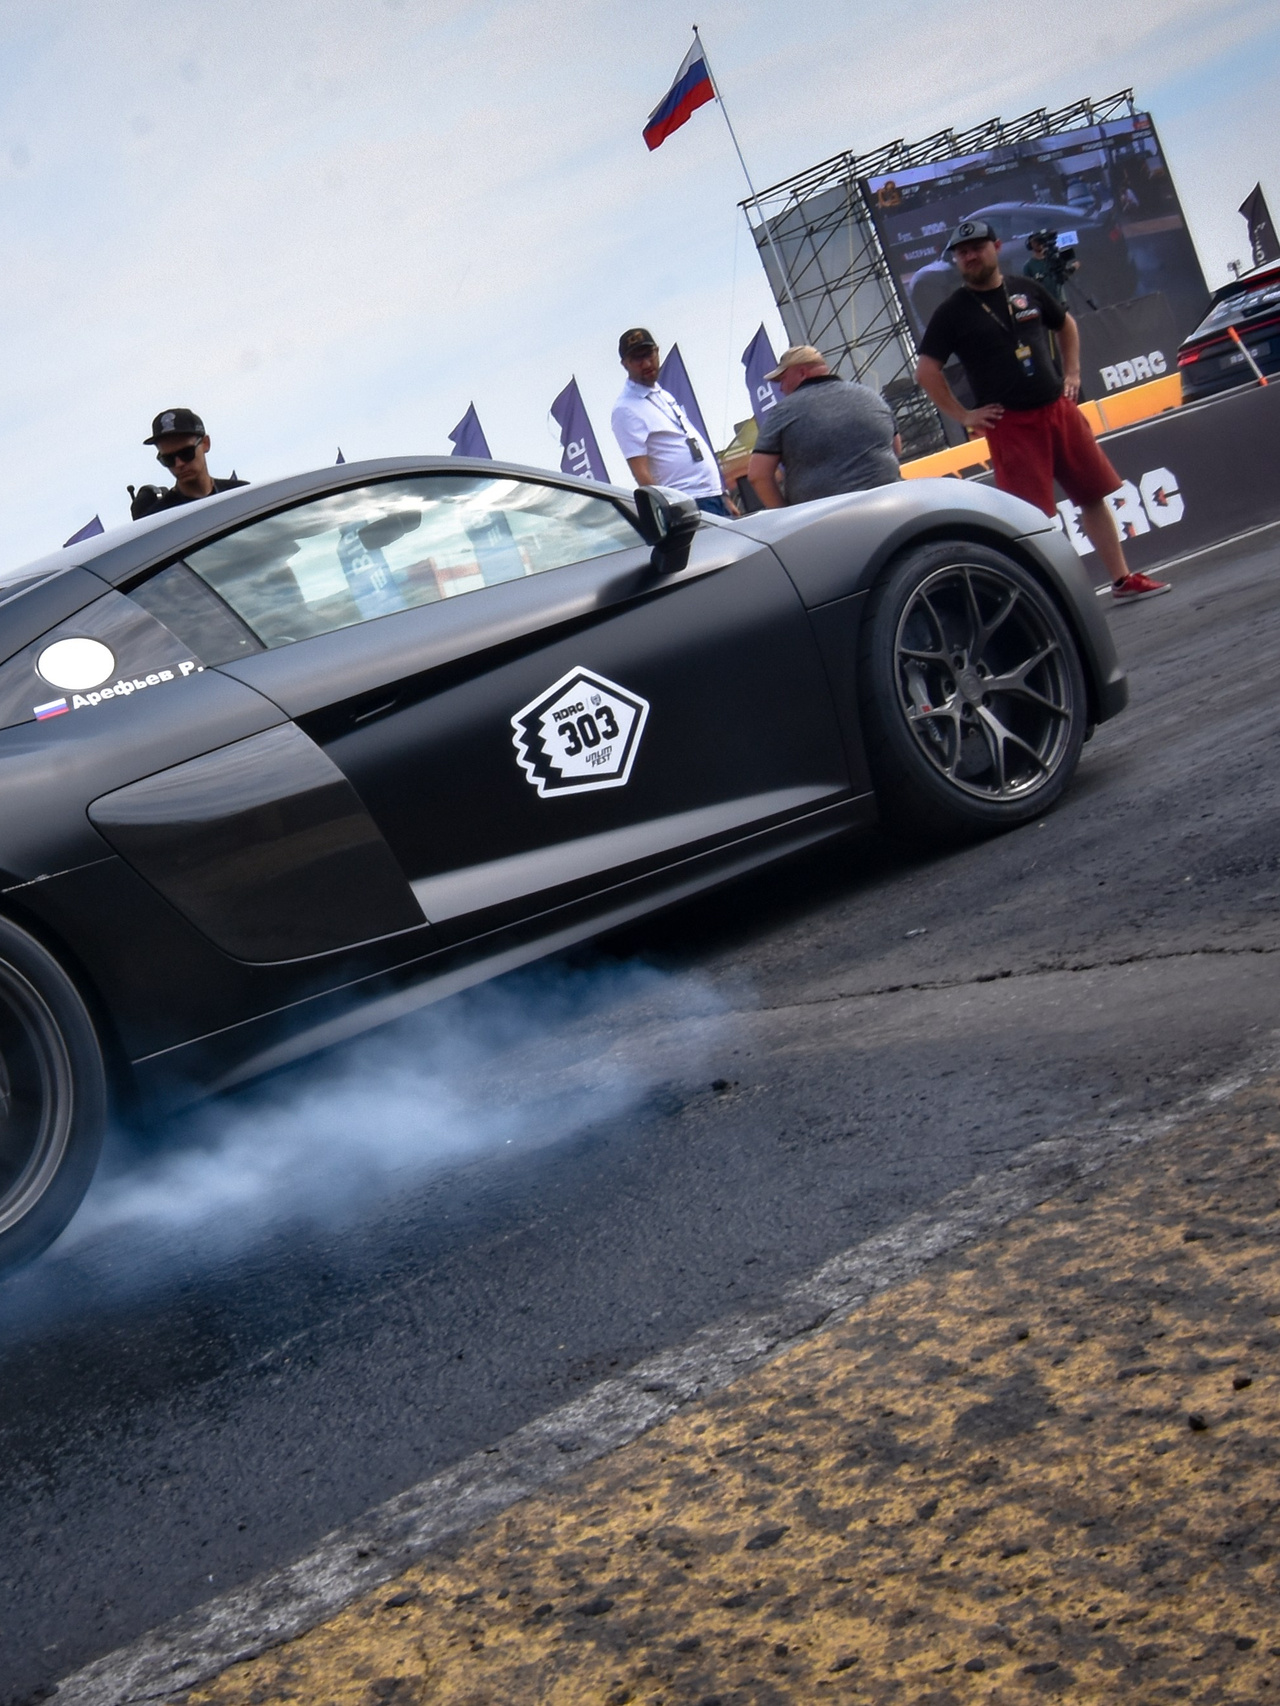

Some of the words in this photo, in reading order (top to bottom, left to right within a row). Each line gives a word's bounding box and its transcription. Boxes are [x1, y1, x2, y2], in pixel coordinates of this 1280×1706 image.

[1099, 350, 1167, 391] RDRC
[1229, 348, 1259, 365] RDC
[1055, 467, 1185, 556] RC
[72, 669, 175, 710] Арефьев
[178, 660, 204, 677] Р.
[552, 702, 585, 723] RDRC
[558, 705, 620, 757] 303
[591, 754, 612, 768] FEST
